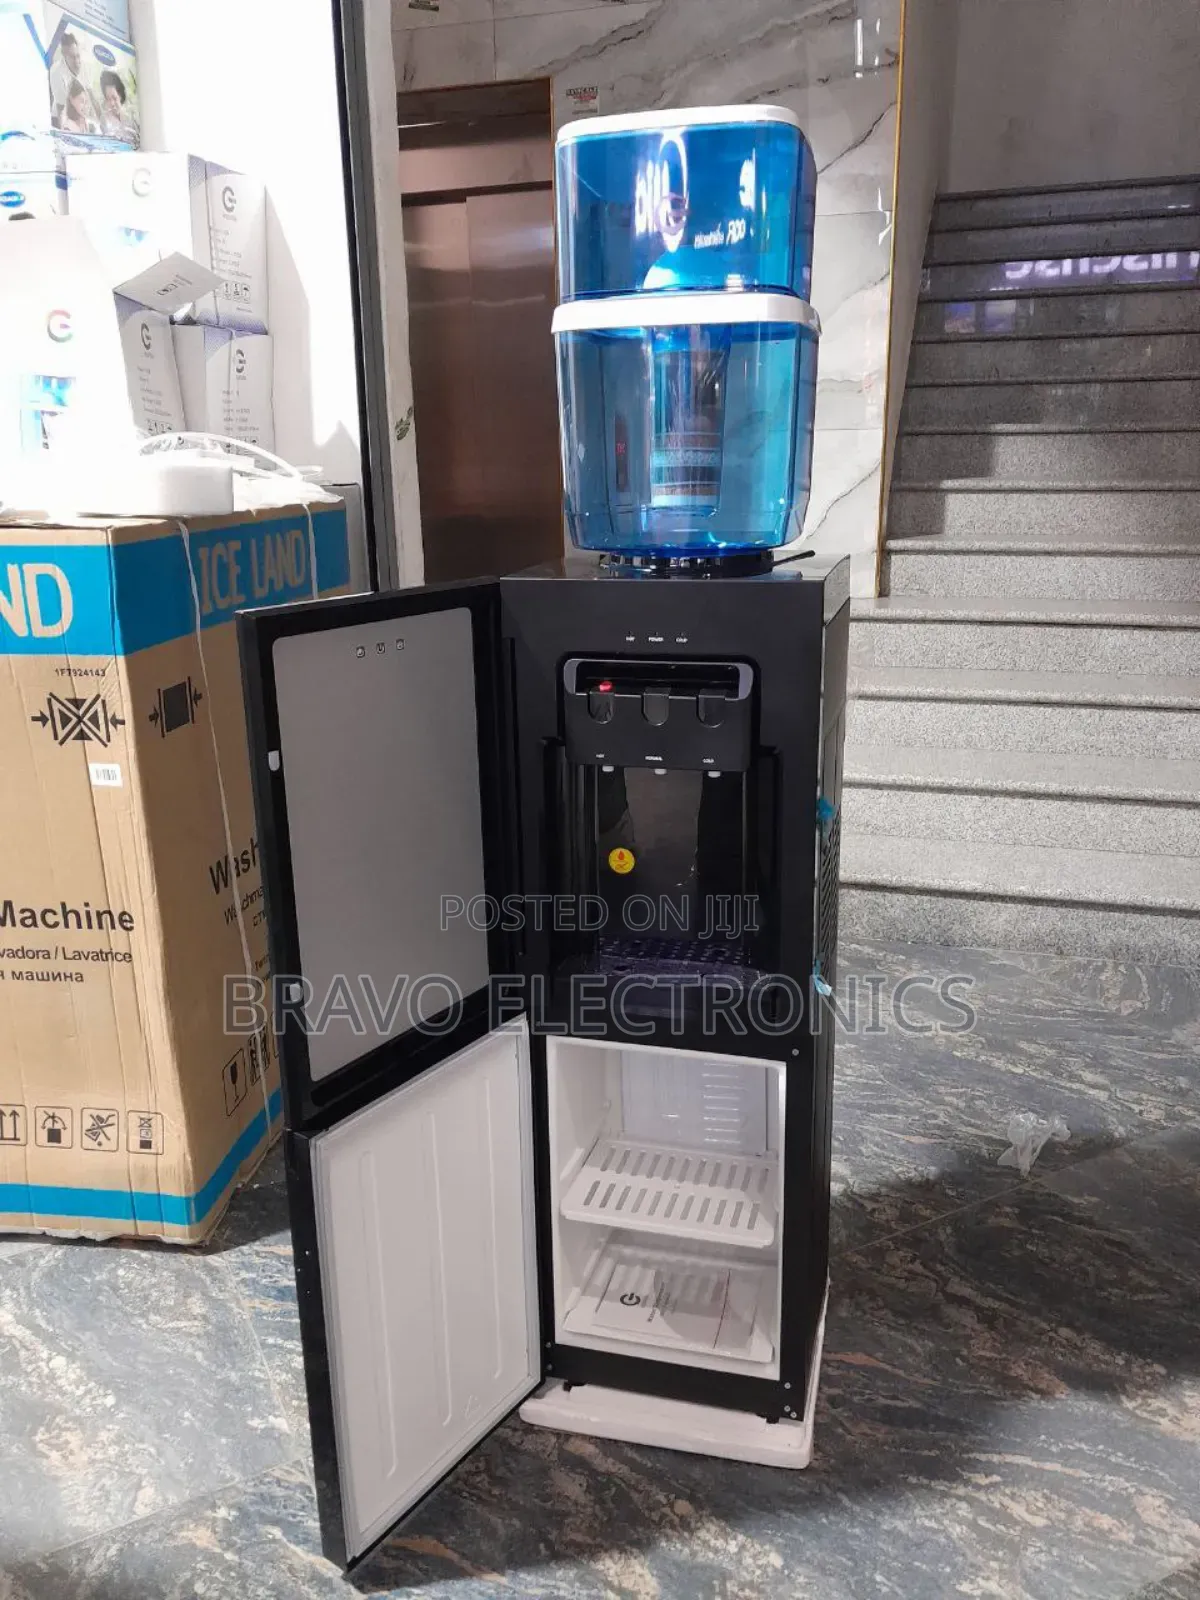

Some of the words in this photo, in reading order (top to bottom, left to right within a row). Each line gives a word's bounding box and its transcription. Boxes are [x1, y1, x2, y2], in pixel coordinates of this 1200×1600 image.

[199, 540, 246, 615] ICE
[251, 530, 306, 598] LAND
[0, 563, 73, 638] ND
[0, 900, 134, 931] Machine
[62, 946, 133, 963] Lavatrice
[11, 969, 84, 982] машина
